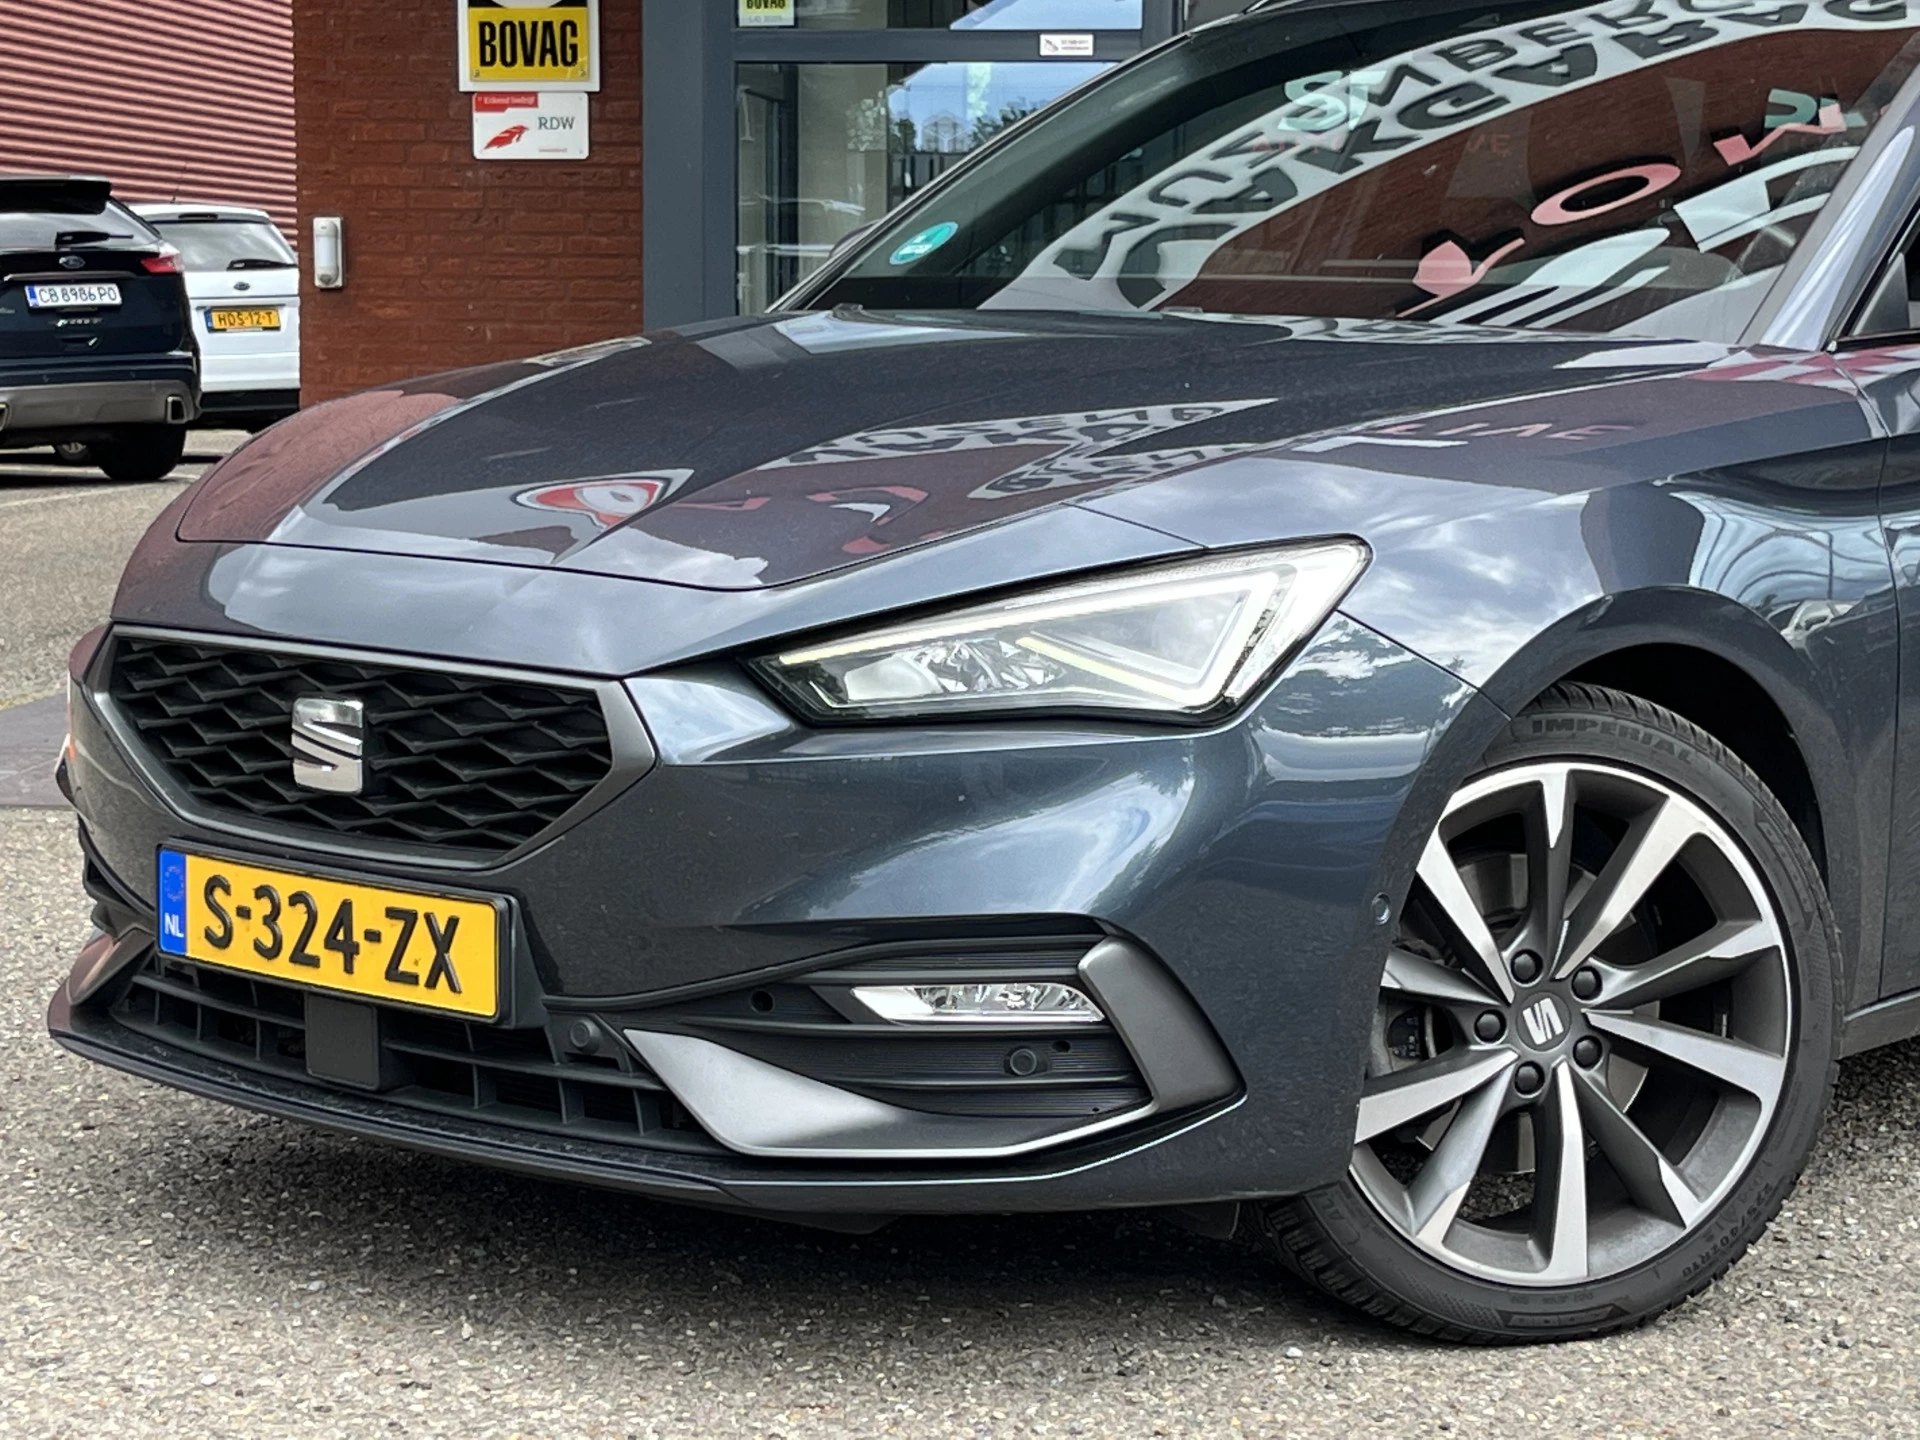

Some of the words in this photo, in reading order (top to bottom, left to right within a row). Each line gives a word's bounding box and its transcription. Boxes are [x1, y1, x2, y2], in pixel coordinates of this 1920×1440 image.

[478, 20, 579, 68] BOVAG
[538, 116, 575, 130] RDW
[1532, 718, 1692, 765] IMPERIAL
[164, 912, 185, 939] NL
[203, 874, 463, 994] S-324-ZX
